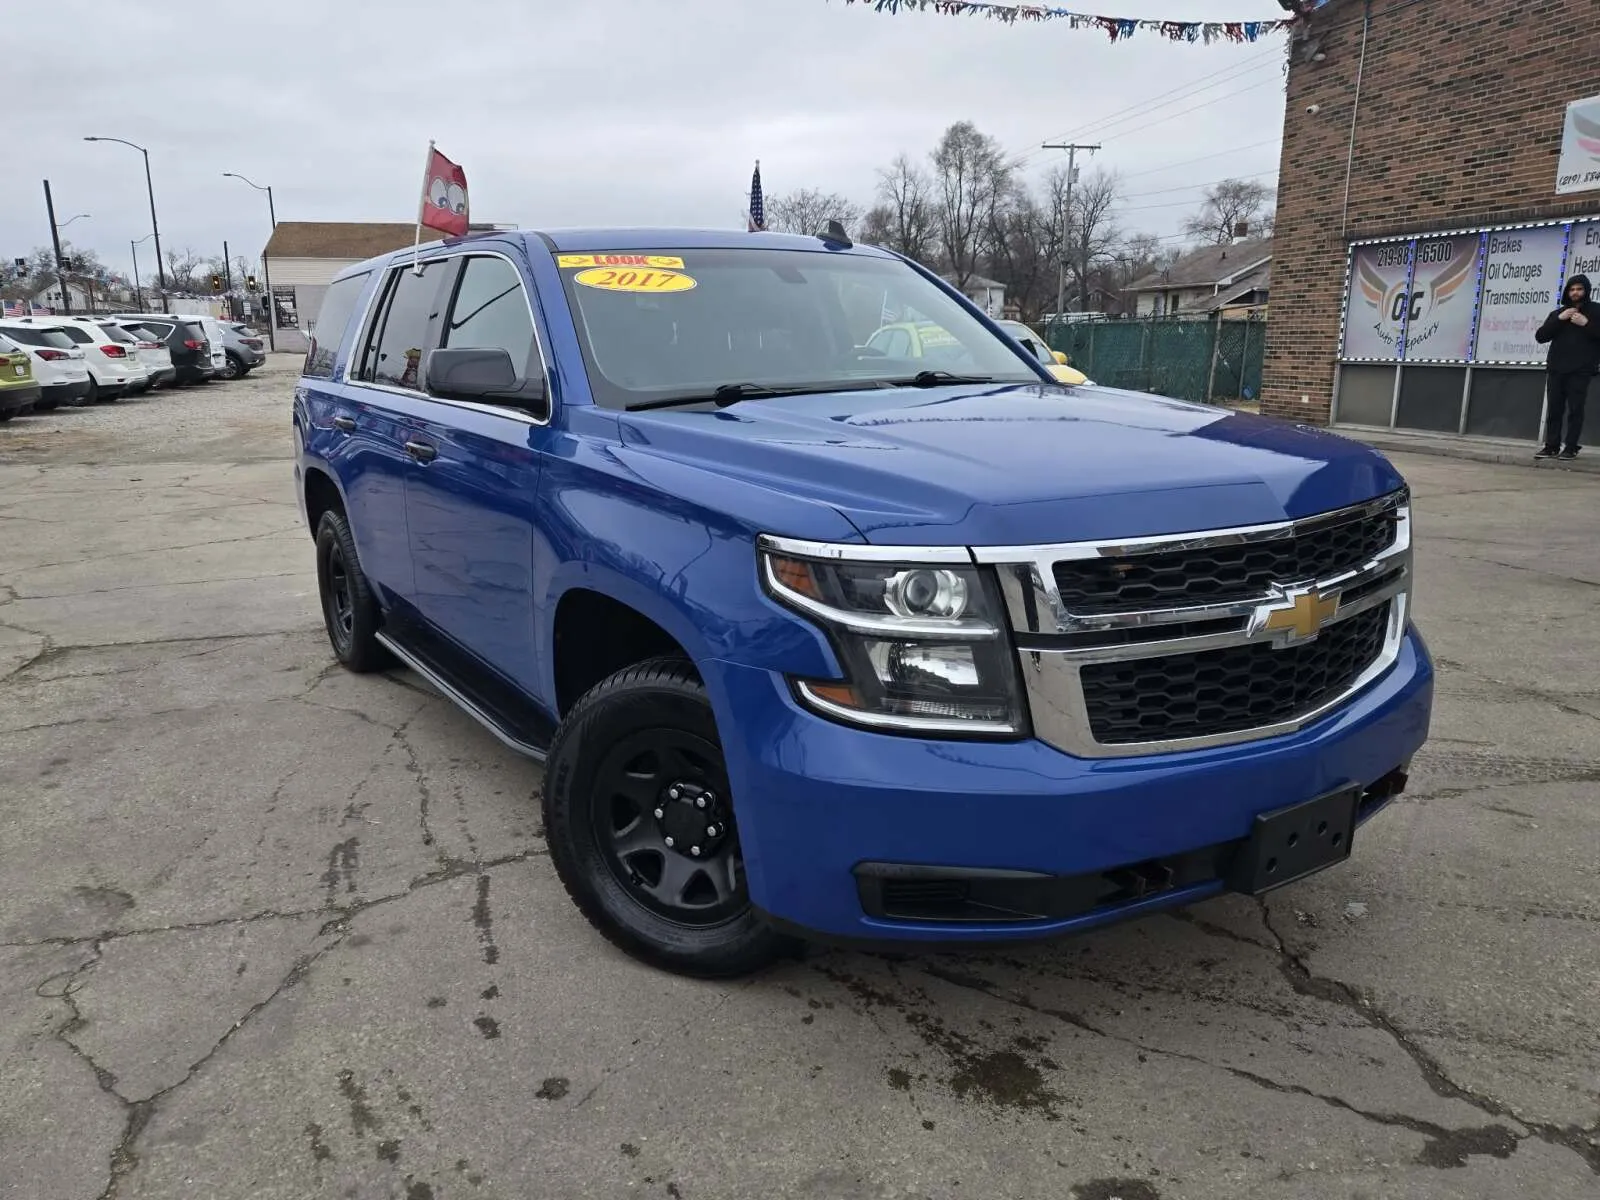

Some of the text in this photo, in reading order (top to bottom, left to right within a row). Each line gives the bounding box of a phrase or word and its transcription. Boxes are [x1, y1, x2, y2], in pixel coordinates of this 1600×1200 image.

[1490, 236, 1522, 254] Brakes
[1585, 227, 1600, 248] En
[594, 255, 648, 265] LOOK
[1377, 241, 1452, 267] 219-88-6500
[598, 271, 676, 288] 2017
[1488, 262, 1543, 282] Oil Changes
[1485, 288, 1550, 305] Transmissions
[1373, 321, 1394, 345] Auto
